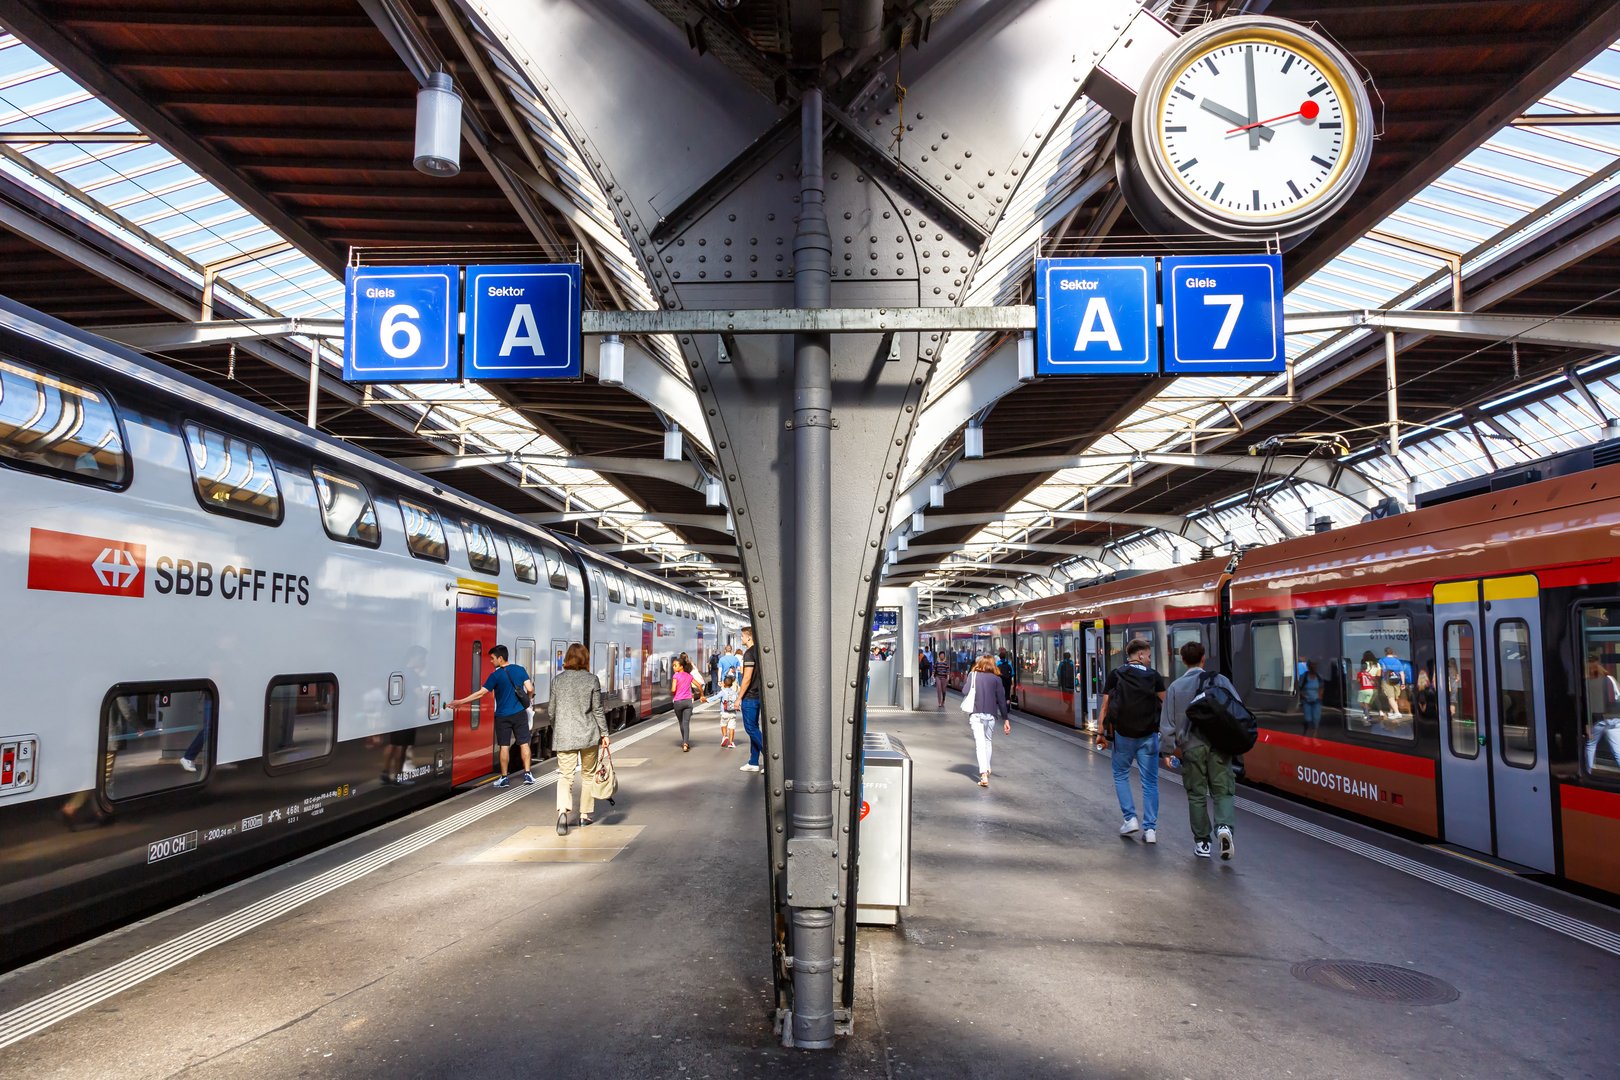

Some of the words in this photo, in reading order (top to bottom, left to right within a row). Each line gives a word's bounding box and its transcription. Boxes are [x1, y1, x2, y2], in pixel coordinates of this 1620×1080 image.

[366, 287, 396, 299] Gleis
[488, 286, 525, 298] Sektor
[1060, 279, 1099, 291] Sektor
[1186, 277, 1217, 289] Gleis
[379, 304, 422, 359] 6
[498, 303, 546, 357] A
[1073, 297, 1123, 352] A
[1203, 294, 1245, 350] 7
[154, 555, 214, 597] SBB
[219, 564, 267, 602] CFF
[271, 571, 310, 606] FFS
[149, 842, 170, 861] 200
[172, 837, 186, 854] CH
